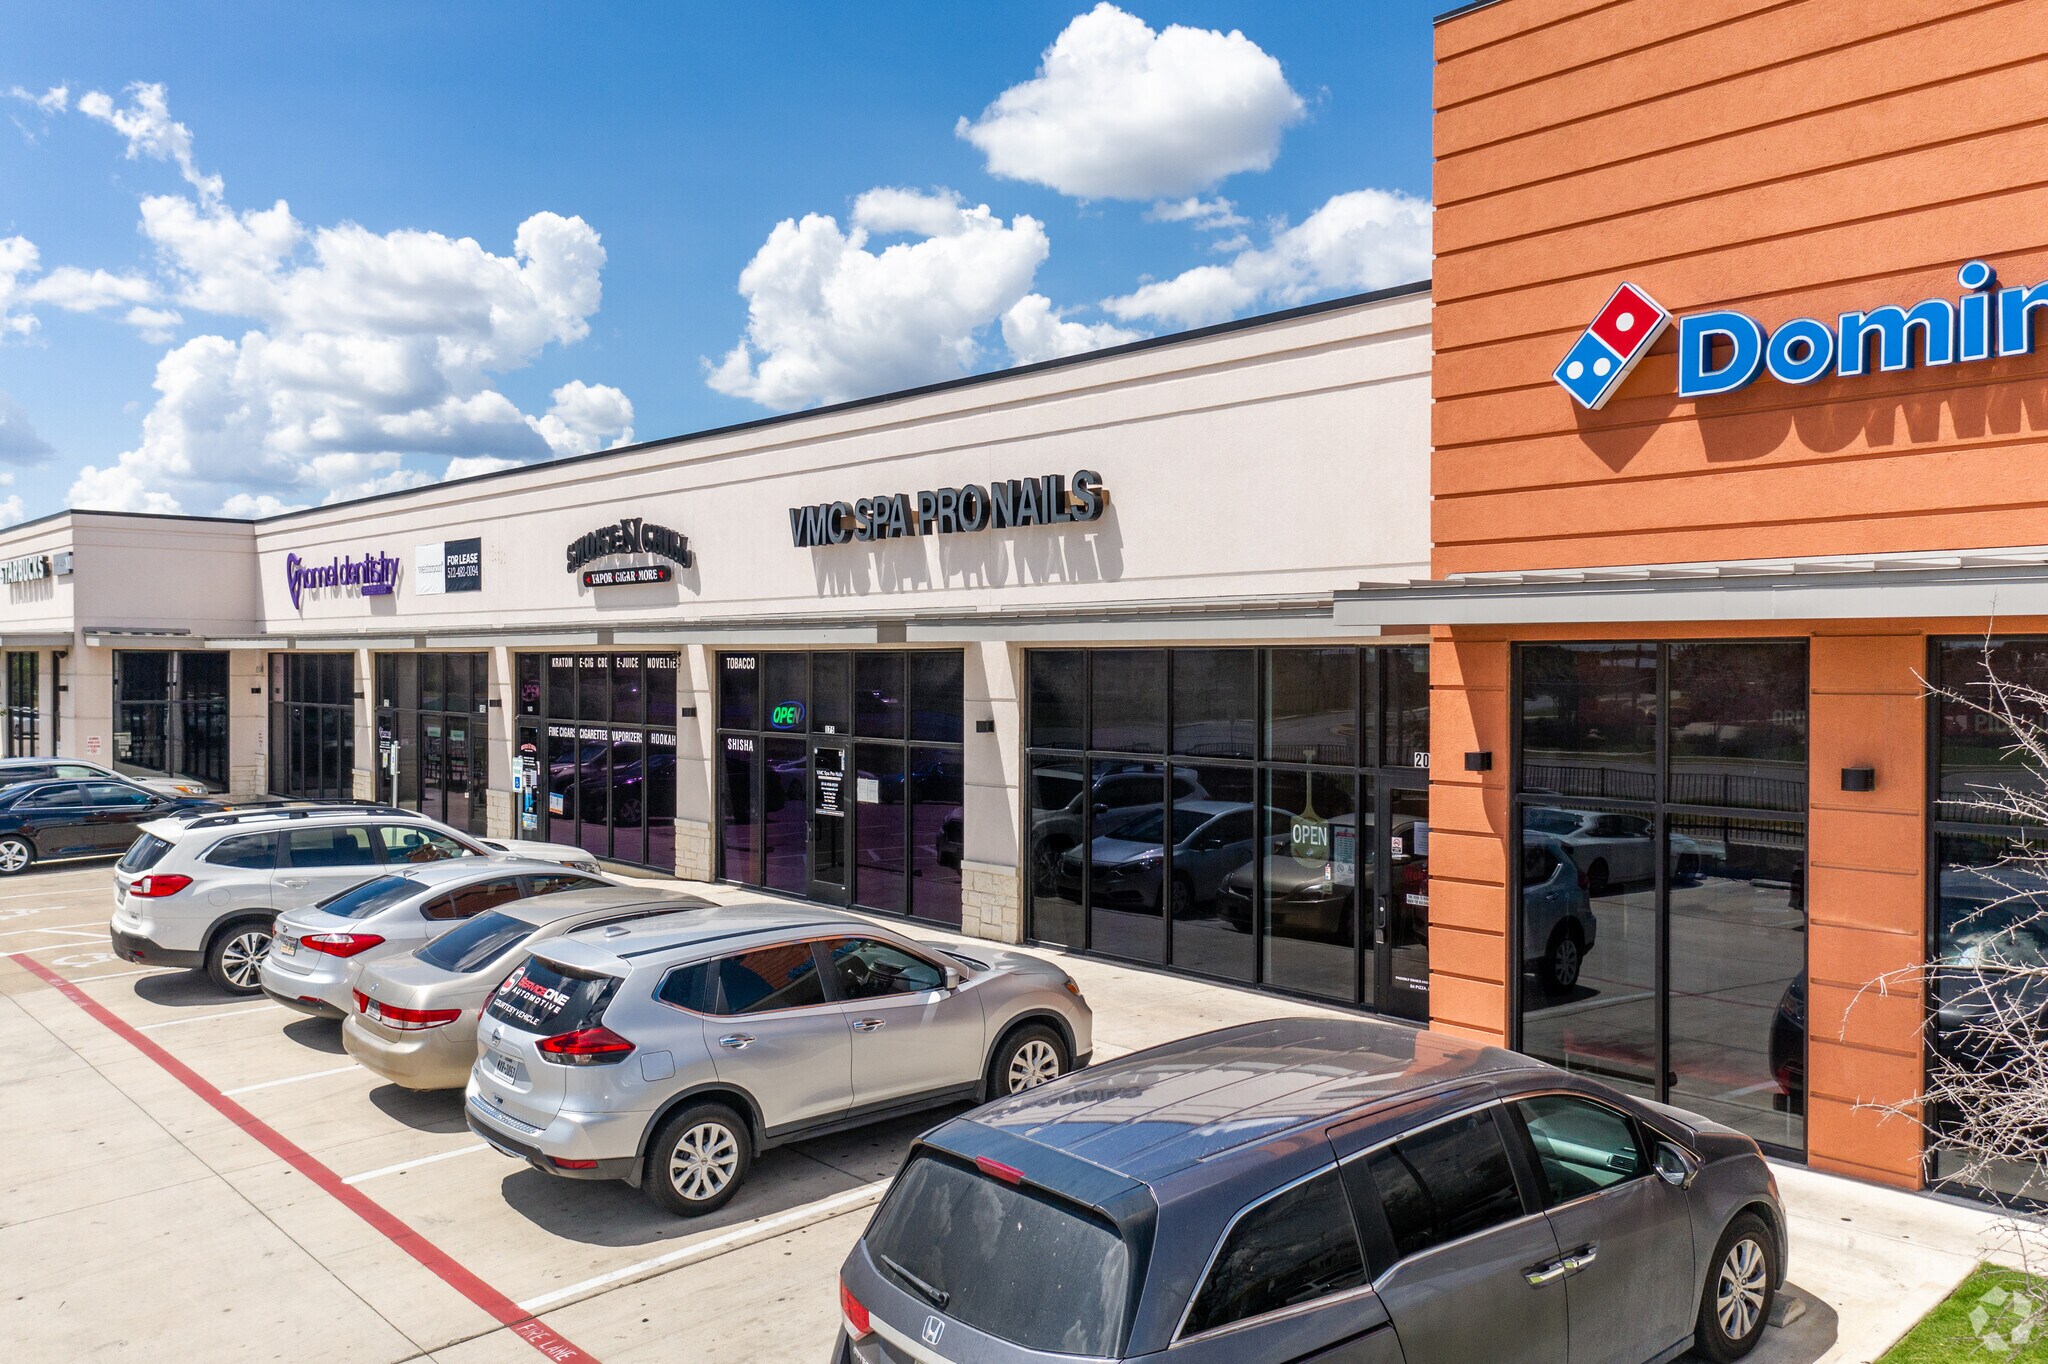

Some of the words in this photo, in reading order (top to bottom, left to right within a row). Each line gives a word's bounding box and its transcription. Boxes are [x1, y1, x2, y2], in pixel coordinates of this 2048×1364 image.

[789, 501, 853, 548] VMC
[854, 493, 915, 542] SPA
[917, 483, 990, 536] PRO
[991, 469, 1104, 530] NAILS
[620, 517, 643, 553] N
[447, 555, 460, 566] FOR
[459, 552, 479, 564] LEASE
[339, 550, 400, 587] dentistry
[591, 572, 613, 584] VAPOR
[638, 569, 658, 582] MORE
[551, 657, 573, 668] KRATOM
[579, 657, 594, 668] E-CIG
[616, 657, 639, 668] E-JUICE
[726, 657, 755, 670] TOBACCO
[773, 706, 801, 724] OPEN
[548, 726, 560, 737] FINE
[579, 729, 608, 741] CIGARETTES
[651, 733, 676, 746] HOOKAH
[727, 738, 754, 752] SHISHA
[1415, 753, 1429, 768] 20
[1292, 824, 1327, 846] OPEN
[511, 986, 562, 1014] AUTOMOTIVE
[494, 998, 516, 1014] COURTESY
[515, 1008, 540, 1026] VEHICLE
[516, 1323, 551, 1342] FIRE
[538, 1339, 577, 1361] LANE
